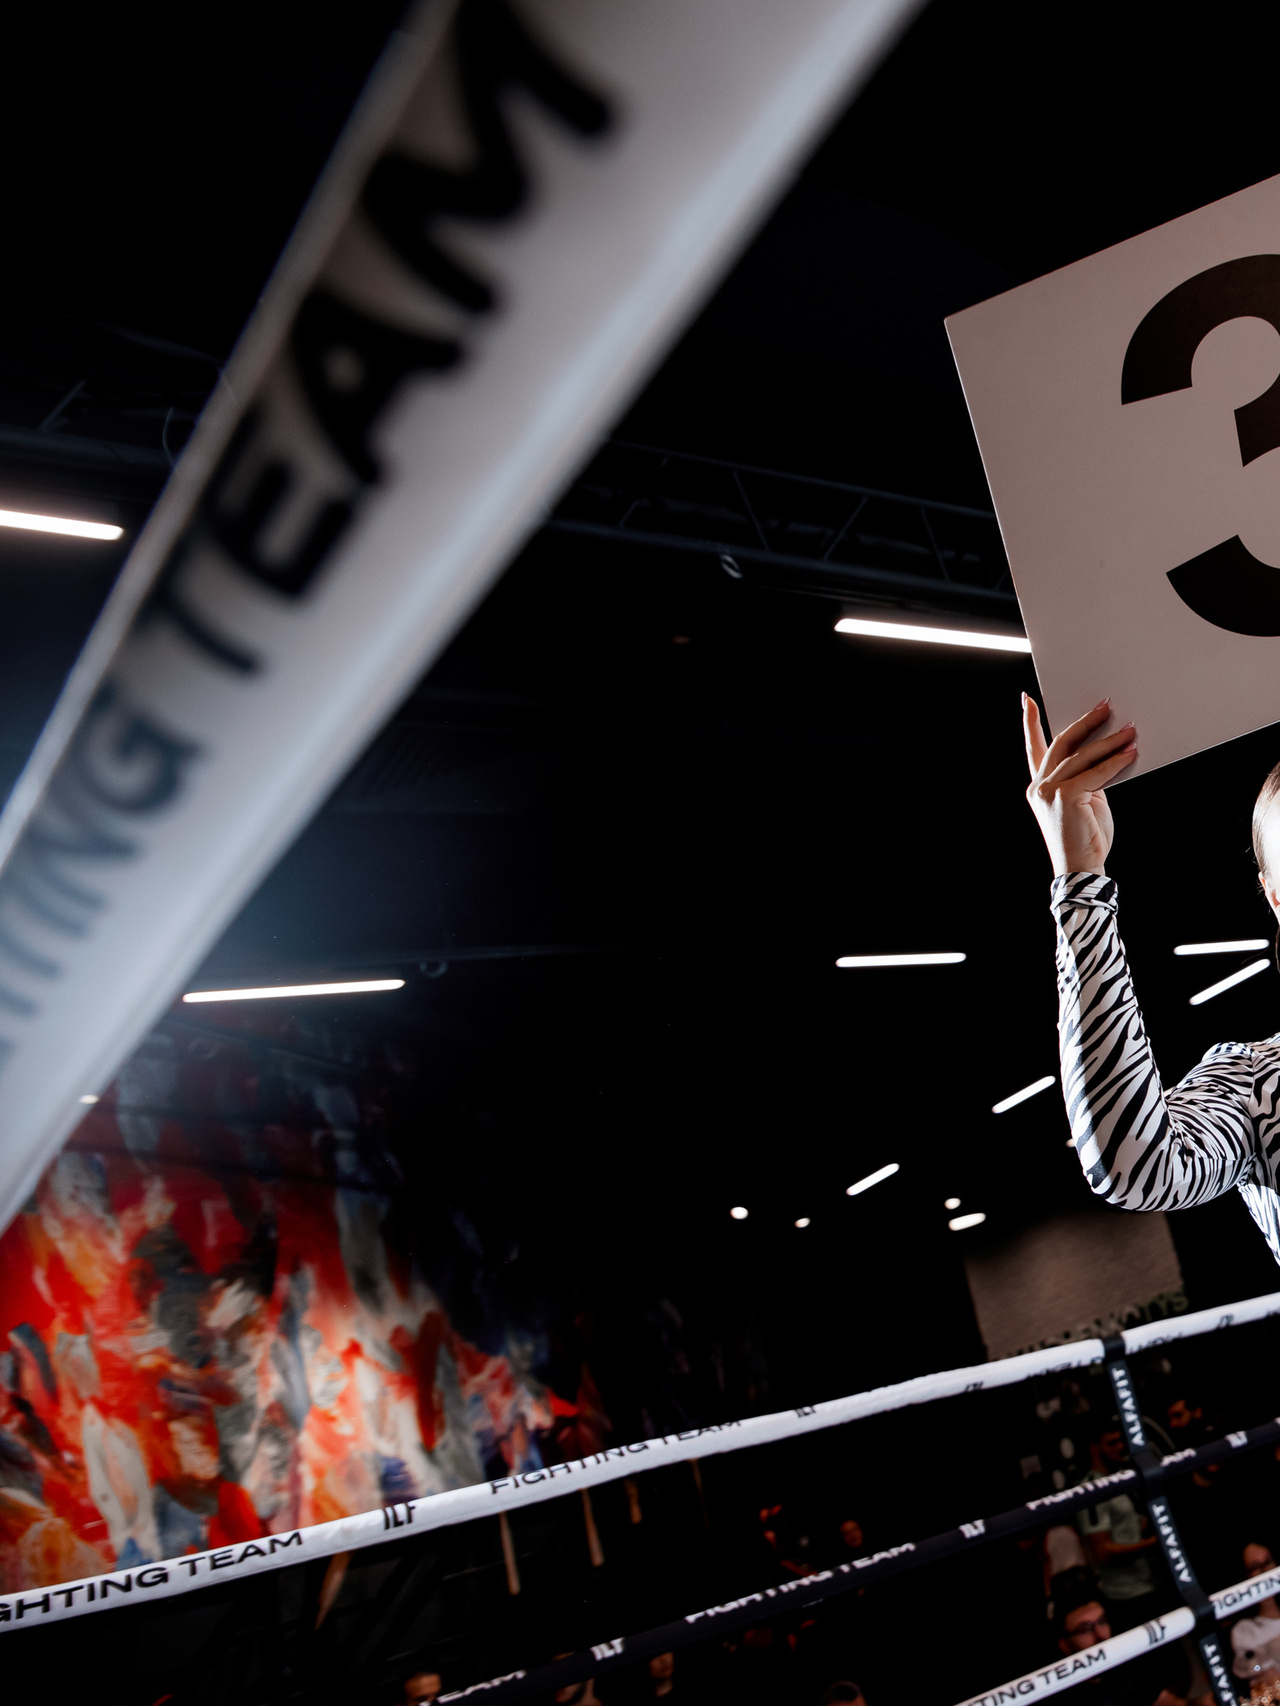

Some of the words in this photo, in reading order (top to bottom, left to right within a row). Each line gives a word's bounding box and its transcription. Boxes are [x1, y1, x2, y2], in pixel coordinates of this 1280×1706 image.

[134, 0, 615, 678] TEAM
[1111, 1366, 1145, 1448] ALFAFIT
[178, 1531, 303, 1579] TEAM
[1151, 1502, 1193, 1584] ALFAFIT
[1041, 1648, 1107, 1687] TEAM
